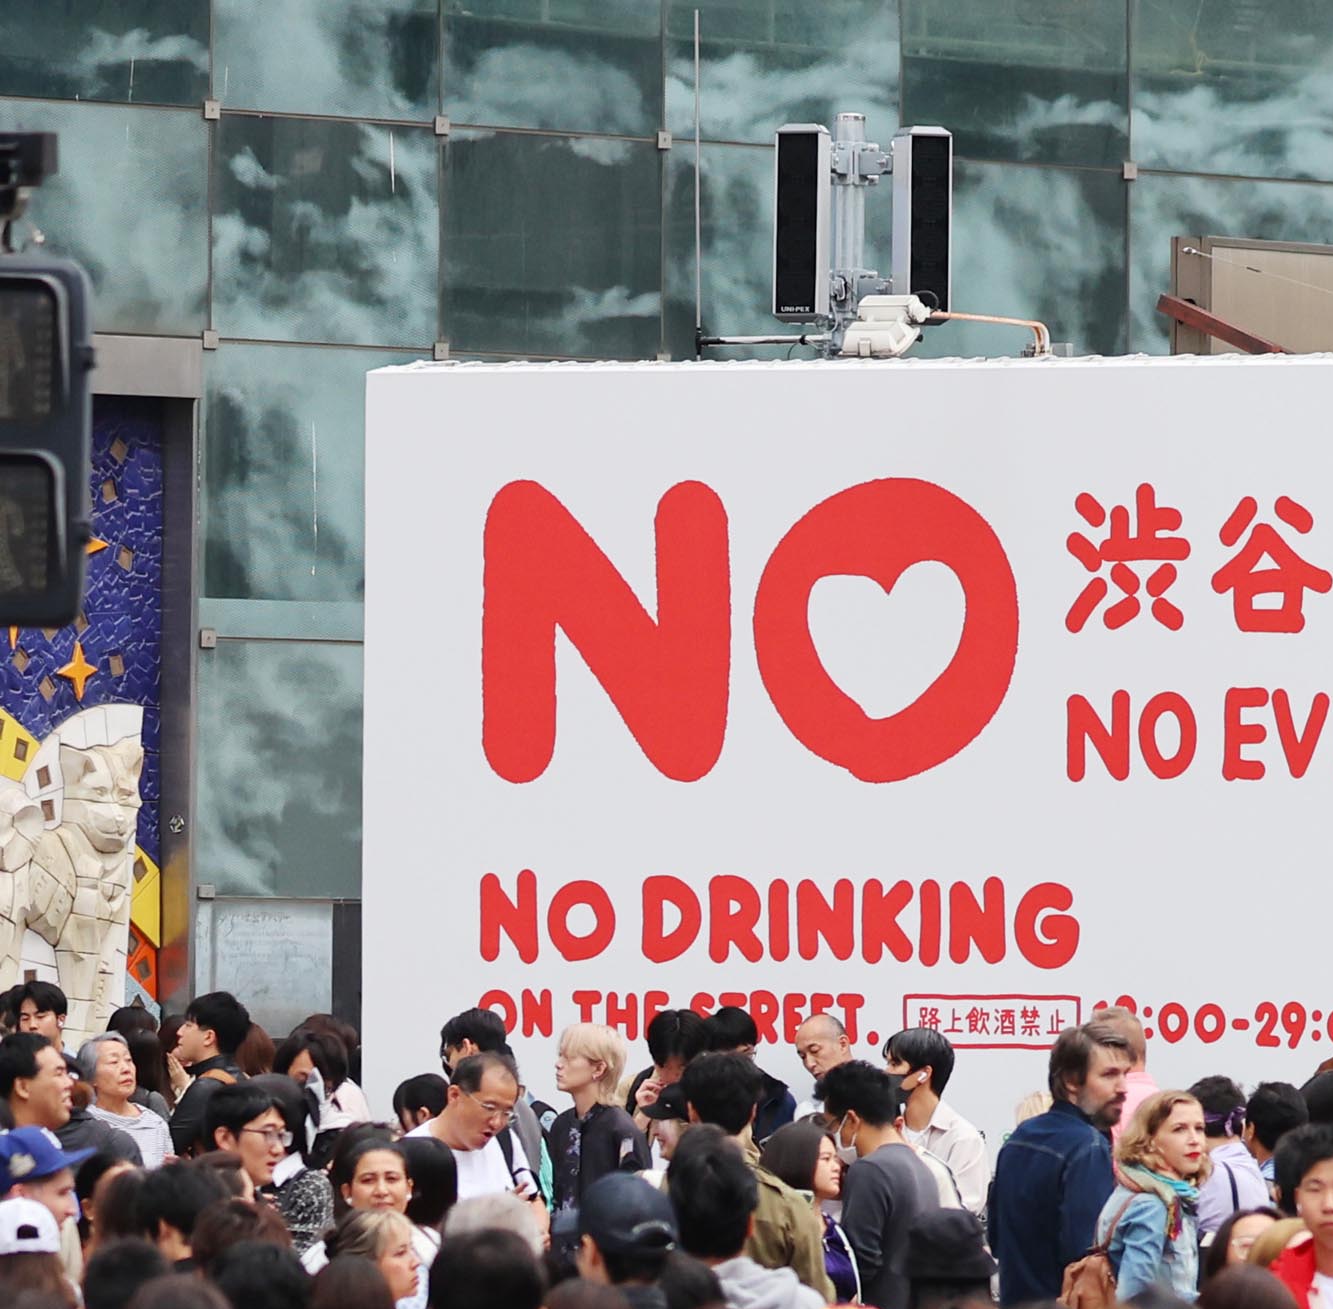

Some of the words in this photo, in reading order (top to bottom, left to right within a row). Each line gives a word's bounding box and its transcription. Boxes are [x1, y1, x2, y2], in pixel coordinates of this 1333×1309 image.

[482, 477, 1019, 784] NO
[1067, 690, 1197, 782] NO
[480, 869, 616, 964] NO
[642, 875, 1080, 969] DRINKING
[478, 989, 553, 1038] ON
